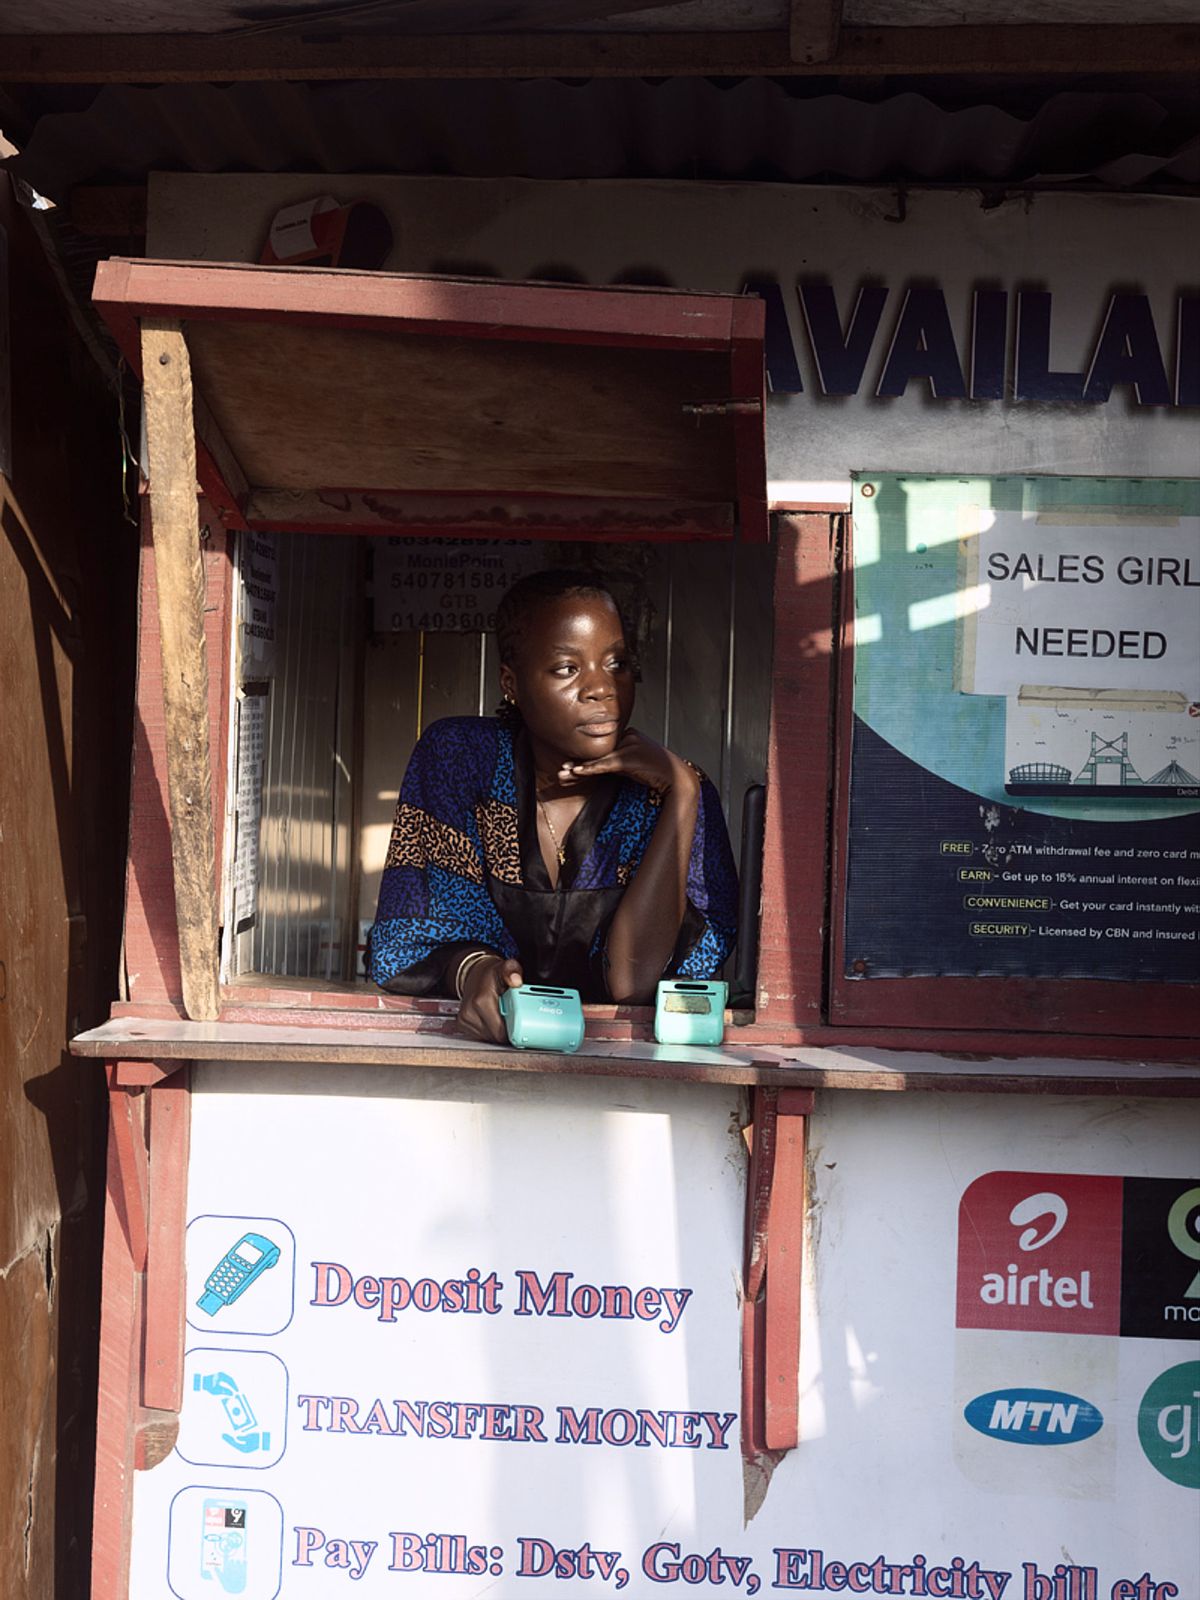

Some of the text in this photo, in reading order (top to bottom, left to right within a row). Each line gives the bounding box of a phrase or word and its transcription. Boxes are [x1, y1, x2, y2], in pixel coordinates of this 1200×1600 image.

[988, 552, 1104, 584] SALES
[1015, 627, 1167, 660] NEEDED
[942, 843, 970, 853] FREE
[1009, 845, 1032, 855] ATM
[1035, 845, 1091, 857] withdrawal
[1094, 846, 1111, 857] fee
[1114, 848, 1134, 858] and
[1137, 849, 1160, 859] zero
[1163, 849, 1187, 859] card
[960, 870, 990, 881] EARN
[1002, 871, 1021, 882] Get
[1025, 873, 1038, 884] up
[1041, 872, 1052, 882] to
[1056, 873, 1077, 883] 15%
[1079, 874, 1115, 884] annual
[1118, 874, 1157, 885] interest
[1160, 877, 1174, 886] on
[1177, 875, 1200, 887] flexi
[968, 897, 1049, 909] CONVENIENCE
[1060, 899, 1080, 910] Get
[1082, 902, 1106, 913] your
[1109, 902, 1133, 911] card
[1136, 902, 1181, 915] instantly
[973, 924, 1028, 935] SECURITY
[1039, 926, 1087, 937] Licensed
[1090, 927, 1102, 939] by
[1105, 928, 1130, 938] CBN
[1132, 929, 1153, 939] and
[1156, 929, 1195, 940] insured
[310, 1261, 692, 1333] Deposit Money
[980, 1263, 1094, 1309] airtel
[298, 1394, 737, 1449] TRANSFER MONEY
[988, 1400, 1079, 1434] MTN
[292, 1526, 378, 1580] Pay
[388, 1531, 503, 1576] Bills:
[516, 1537, 630, 1589] Dstv,
[642, 1542, 761, 1595] Gotv,
[772, 1548, 1011, 1600] Electricity
[1023, 1562, 1097, 1600] bill
